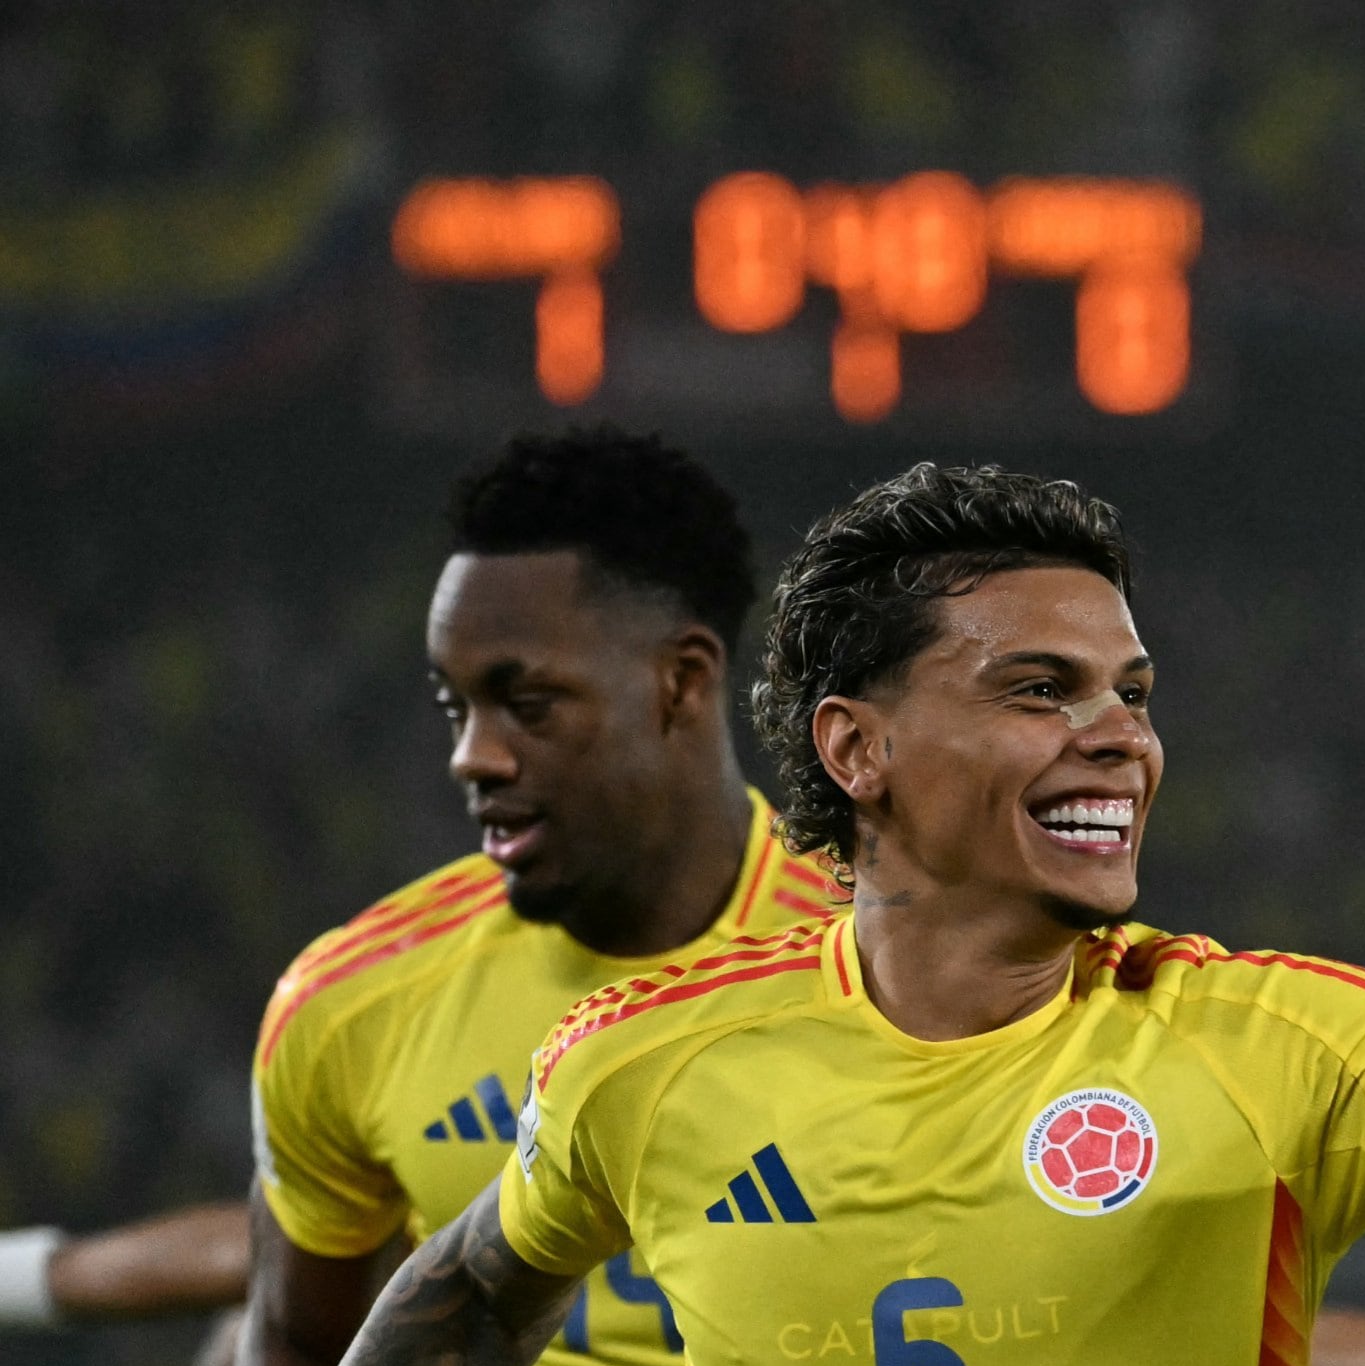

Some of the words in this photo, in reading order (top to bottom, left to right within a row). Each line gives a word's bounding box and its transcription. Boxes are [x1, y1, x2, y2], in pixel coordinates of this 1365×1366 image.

[1055, 1091, 1117, 1112] COLOMBIANA
[1117, 1098, 1130, 1109] DE
[777, 1296, 1068, 1360] CATPULT
